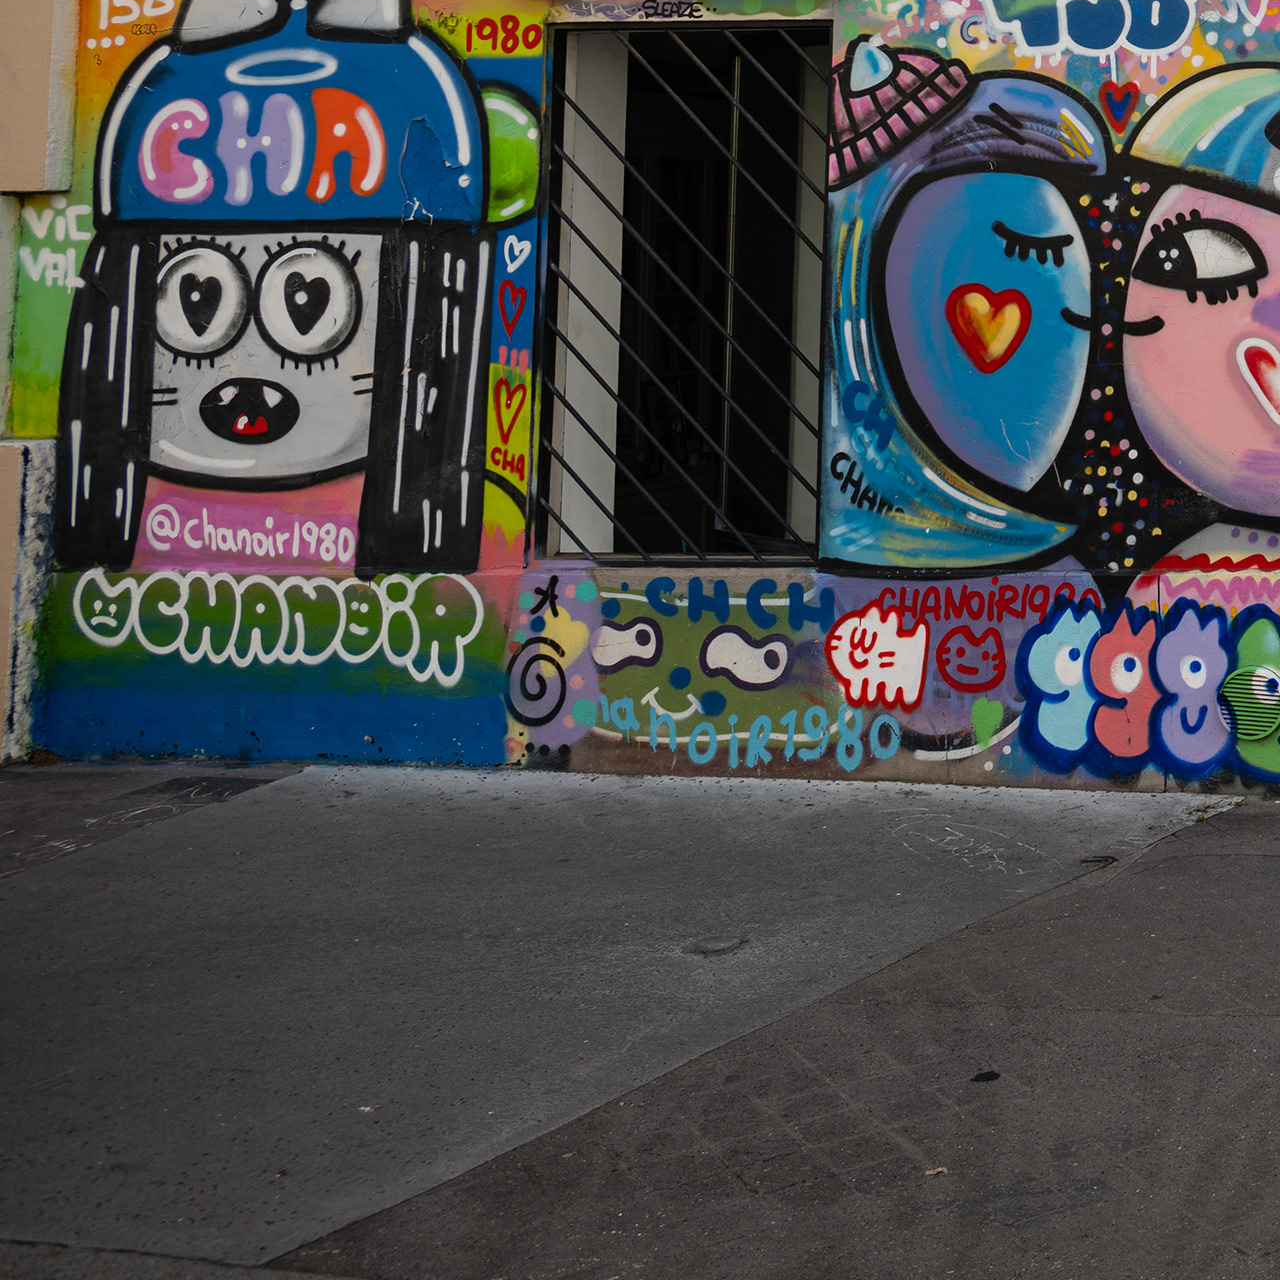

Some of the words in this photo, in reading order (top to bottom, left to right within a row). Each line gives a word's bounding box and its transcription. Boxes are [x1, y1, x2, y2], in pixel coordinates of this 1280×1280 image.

[466, 15, 542, 54] 1980
[138, 87, 388, 206] CHA
[490, 447, 525, 480] CHA
[146, 503, 356, 563] @chanoir1980
